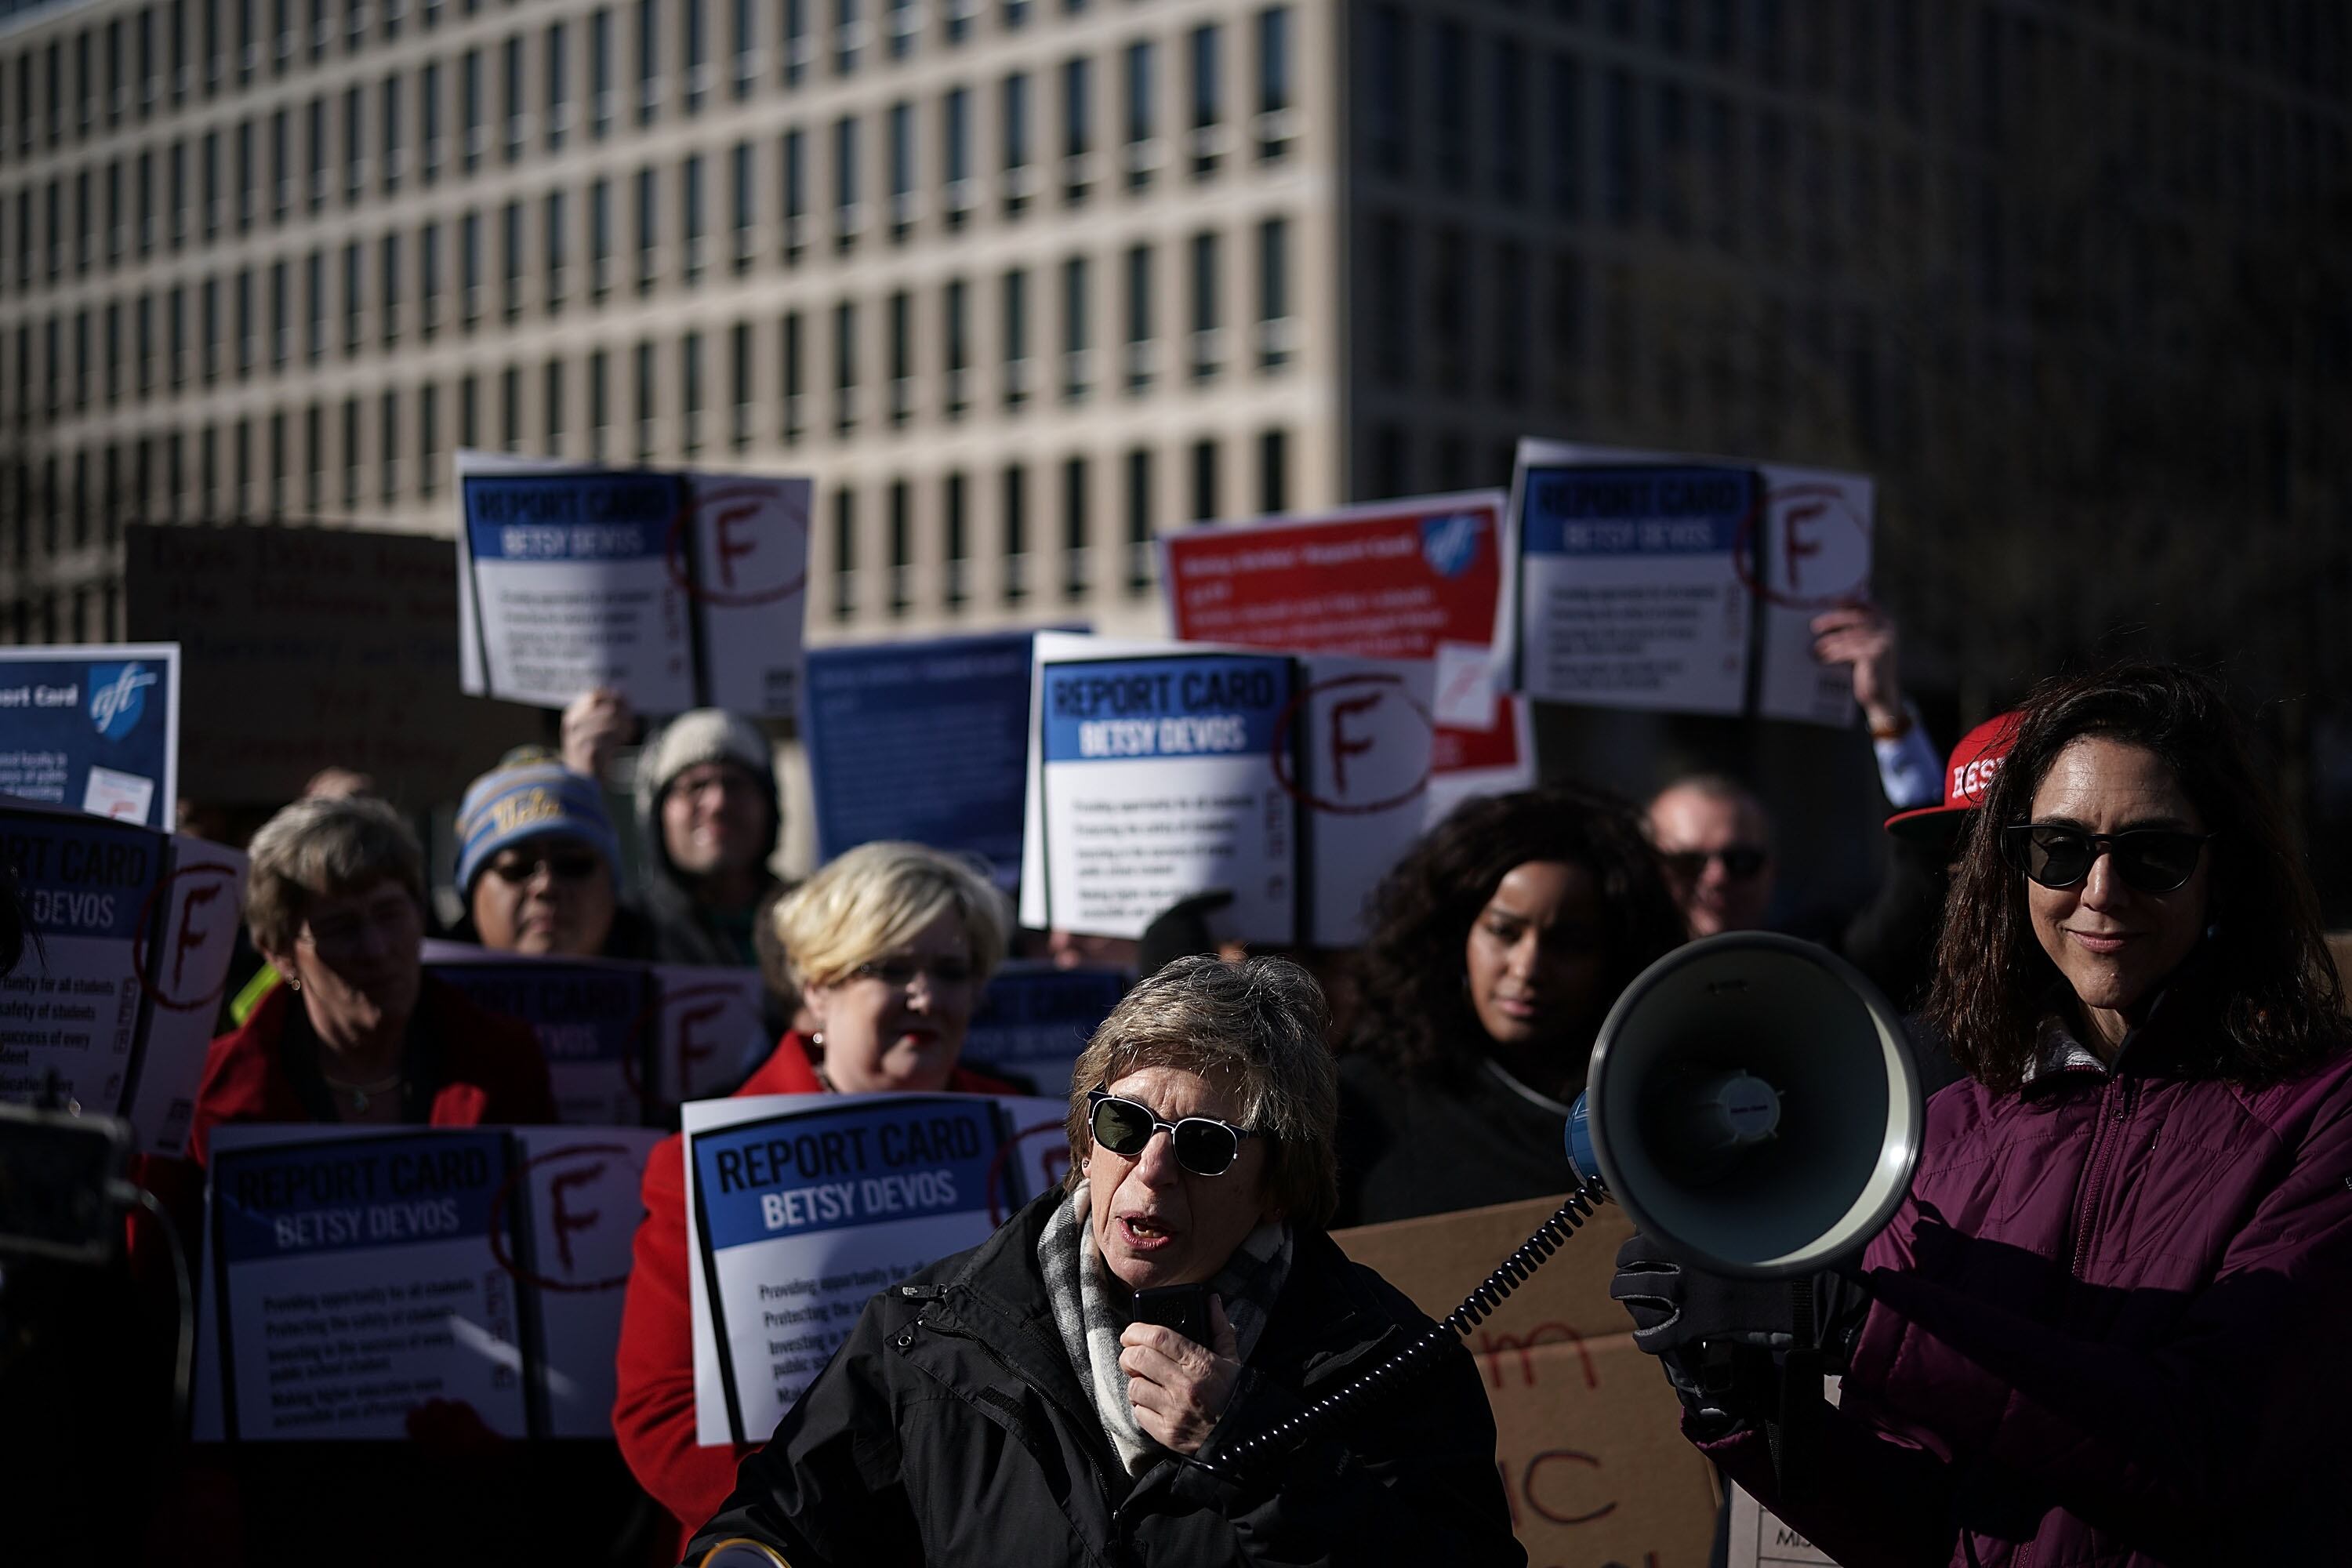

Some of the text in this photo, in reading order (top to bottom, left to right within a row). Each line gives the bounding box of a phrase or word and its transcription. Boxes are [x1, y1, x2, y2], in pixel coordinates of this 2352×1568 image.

[717, 502, 760, 588] F
[1787, 503, 1827, 590] F
[34, 683, 78, 707] Card
[1054, 673, 1171, 717] REPORT
[1181, 670, 1276, 710] CARD
[1079, 717, 1247, 757] BETSY DEVOS
[1331, 695, 1381, 795] F
[61, 839, 147, 887] CARD
[33, 888, 114, 927] DEVOS
[173, 884, 222, 992] F
[680, 1002, 724, 1095] F
[238, 1149, 488, 1209] REPORT CARD
[716, 1127, 867, 1194] REPORT
[878, 1116, 981, 1173] CARD
[275, 1199, 460, 1248] BETSY DEVOS
[552, 1164, 604, 1273] F
[760, 1170, 959, 1231] BETSY DEVOS
[264, 1294, 317, 1313] Providing
[758, 1279, 817, 1301] Providing
[265, 1319, 327, 1338] Protecting
[764, 1305, 829, 1327] Protecting
[768, 1334, 826, 1356] Investing
